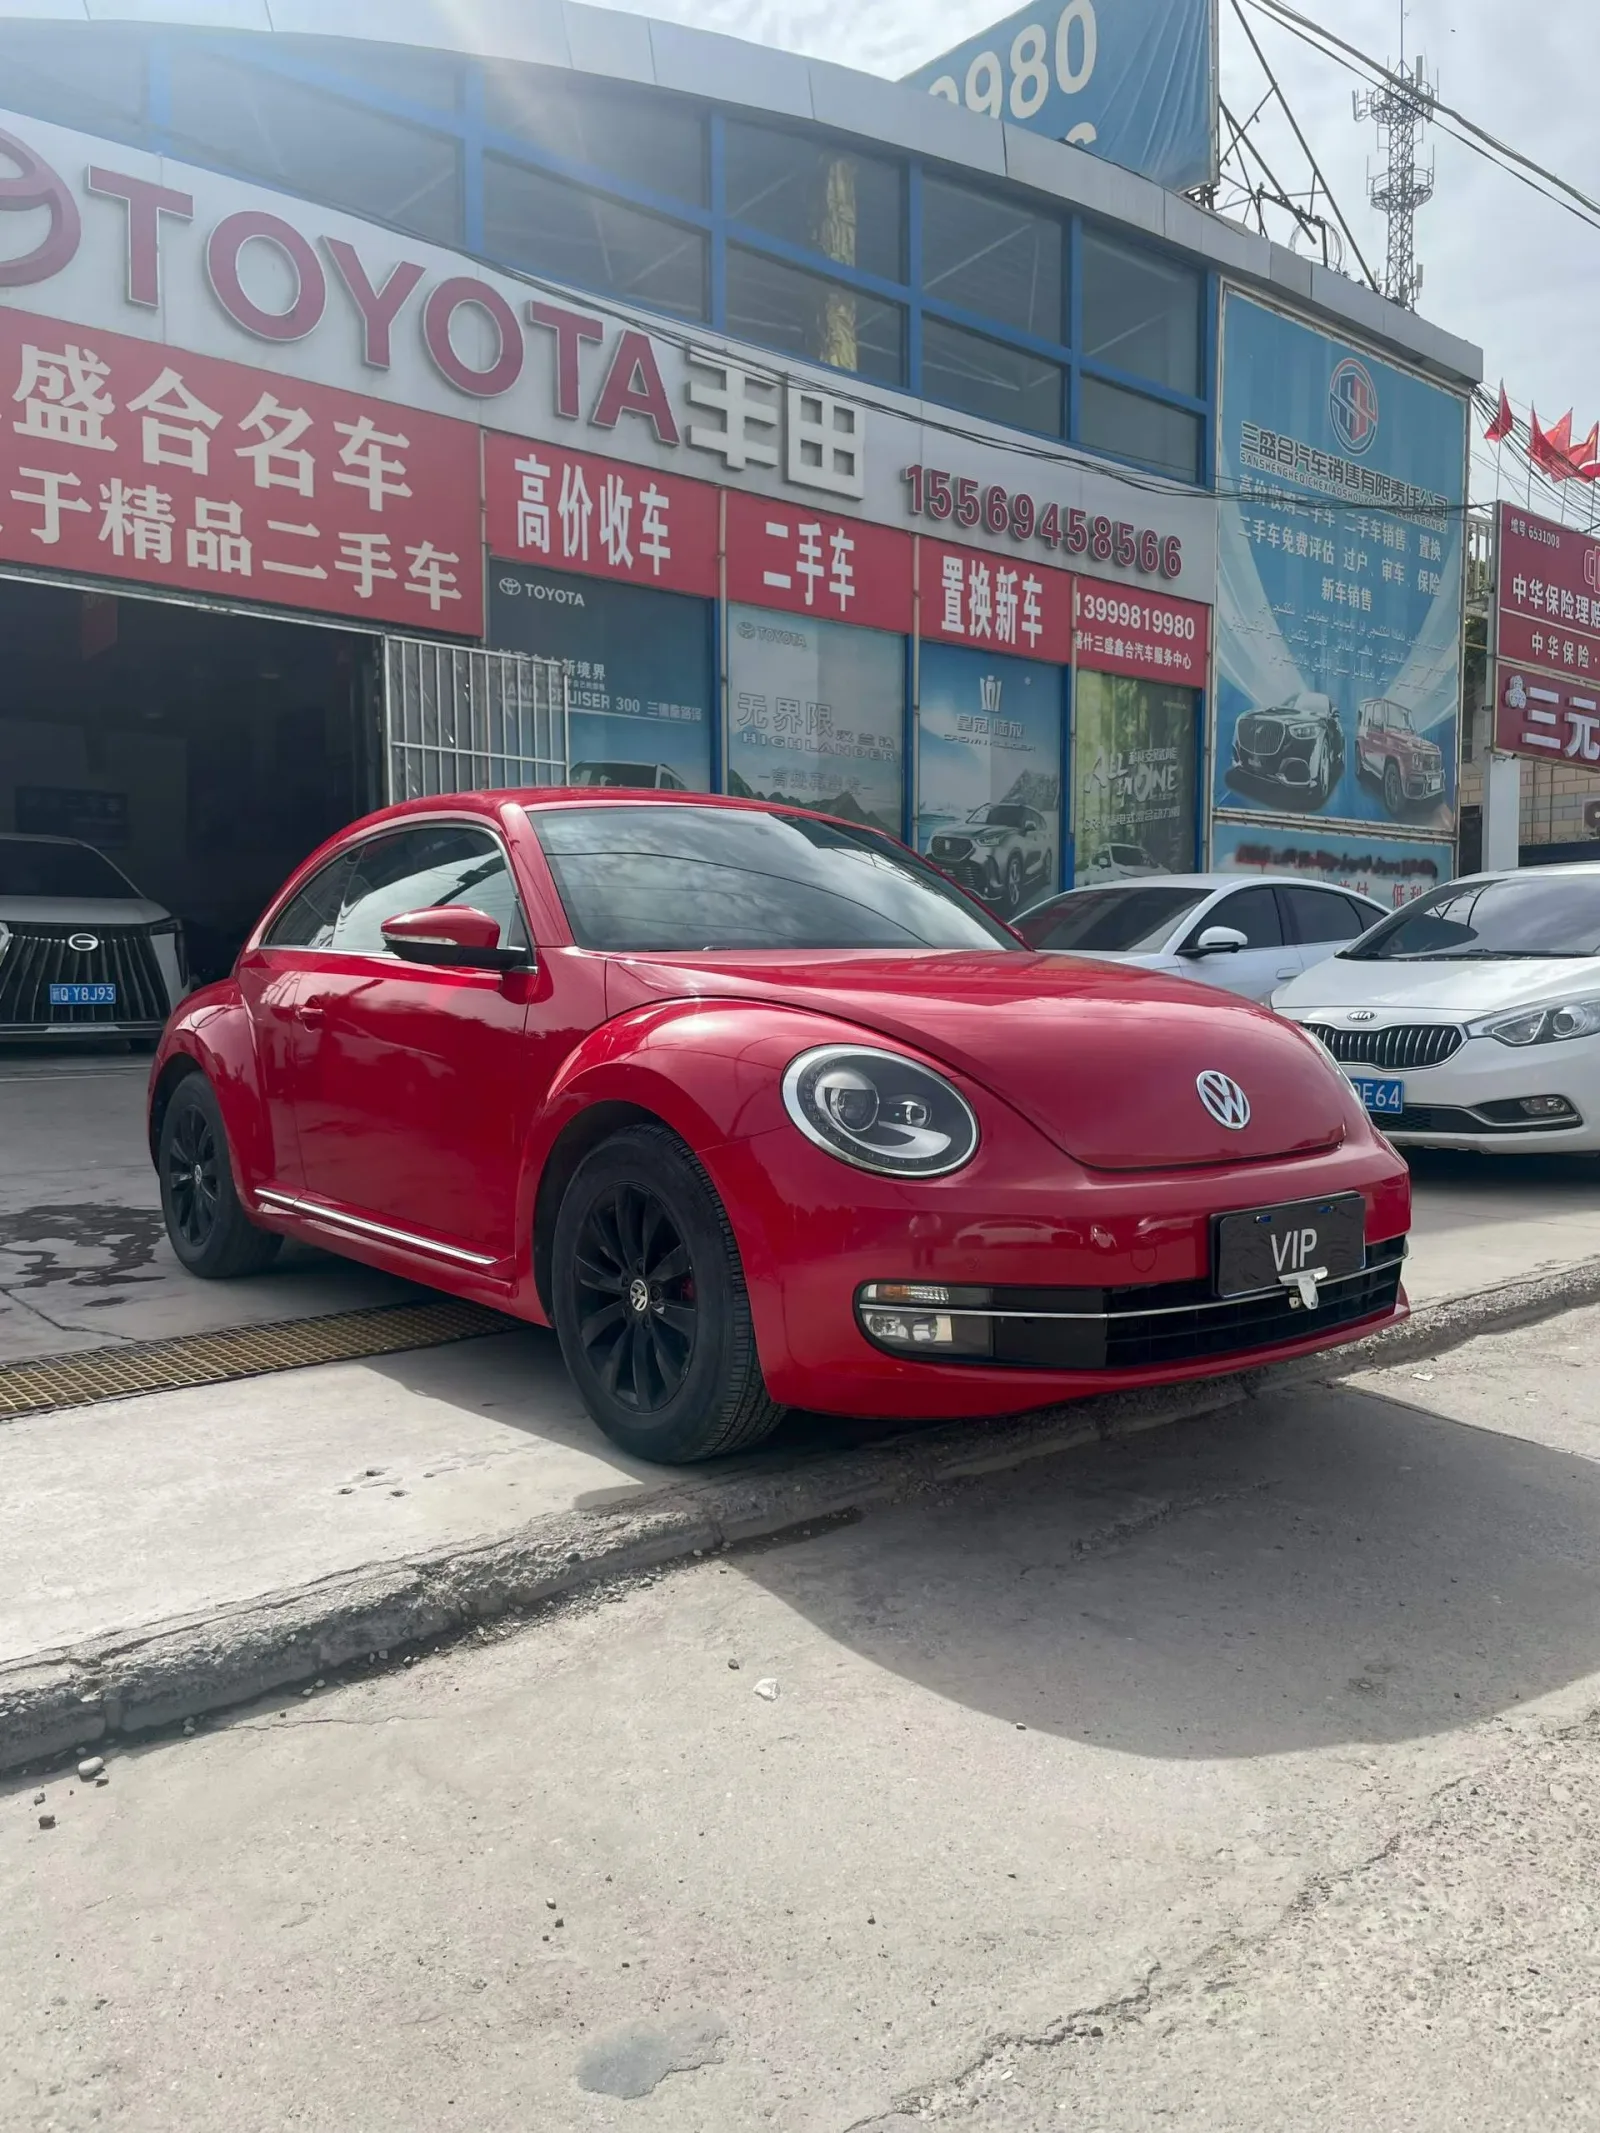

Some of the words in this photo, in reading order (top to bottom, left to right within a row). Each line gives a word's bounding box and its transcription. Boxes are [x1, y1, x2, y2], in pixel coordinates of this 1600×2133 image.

[88, 164, 681, 446] TOYOTA
[0, 343, 414, 513] 盛合名车
[686, 344, 865, 500] 丰田
[1240, 421, 1448, 521] 三盛合汽车销售有限责任公司
[0, 466, 463, 611] 于精品二手车
[514, 453, 671, 576] 高价收车
[902, 463, 1184, 579] 15569458566
[1528, 525, 1560, 549] 6531008
[1238, 516, 1335, 566] 二手车免费评估
[763, 521, 855, 613] 二手车
[524, 582, 585, 607] TOYOTA
[941, 554, 1043, 648] 置换新车
[1076, 592, 1195, 640] 13999819980
[1321, 577, 1373, 612] 新车销售
[757, 626, 807, 648] TOYOTA
[615, 697, 641, 713] 300
[736, 692, 834, 737] 无界限
[742, 731, 898, 763] HIGHLANDER
[1350, 1011, 1374, 1021] KIA
[1270, 1228, 1317, 1272] VIP
